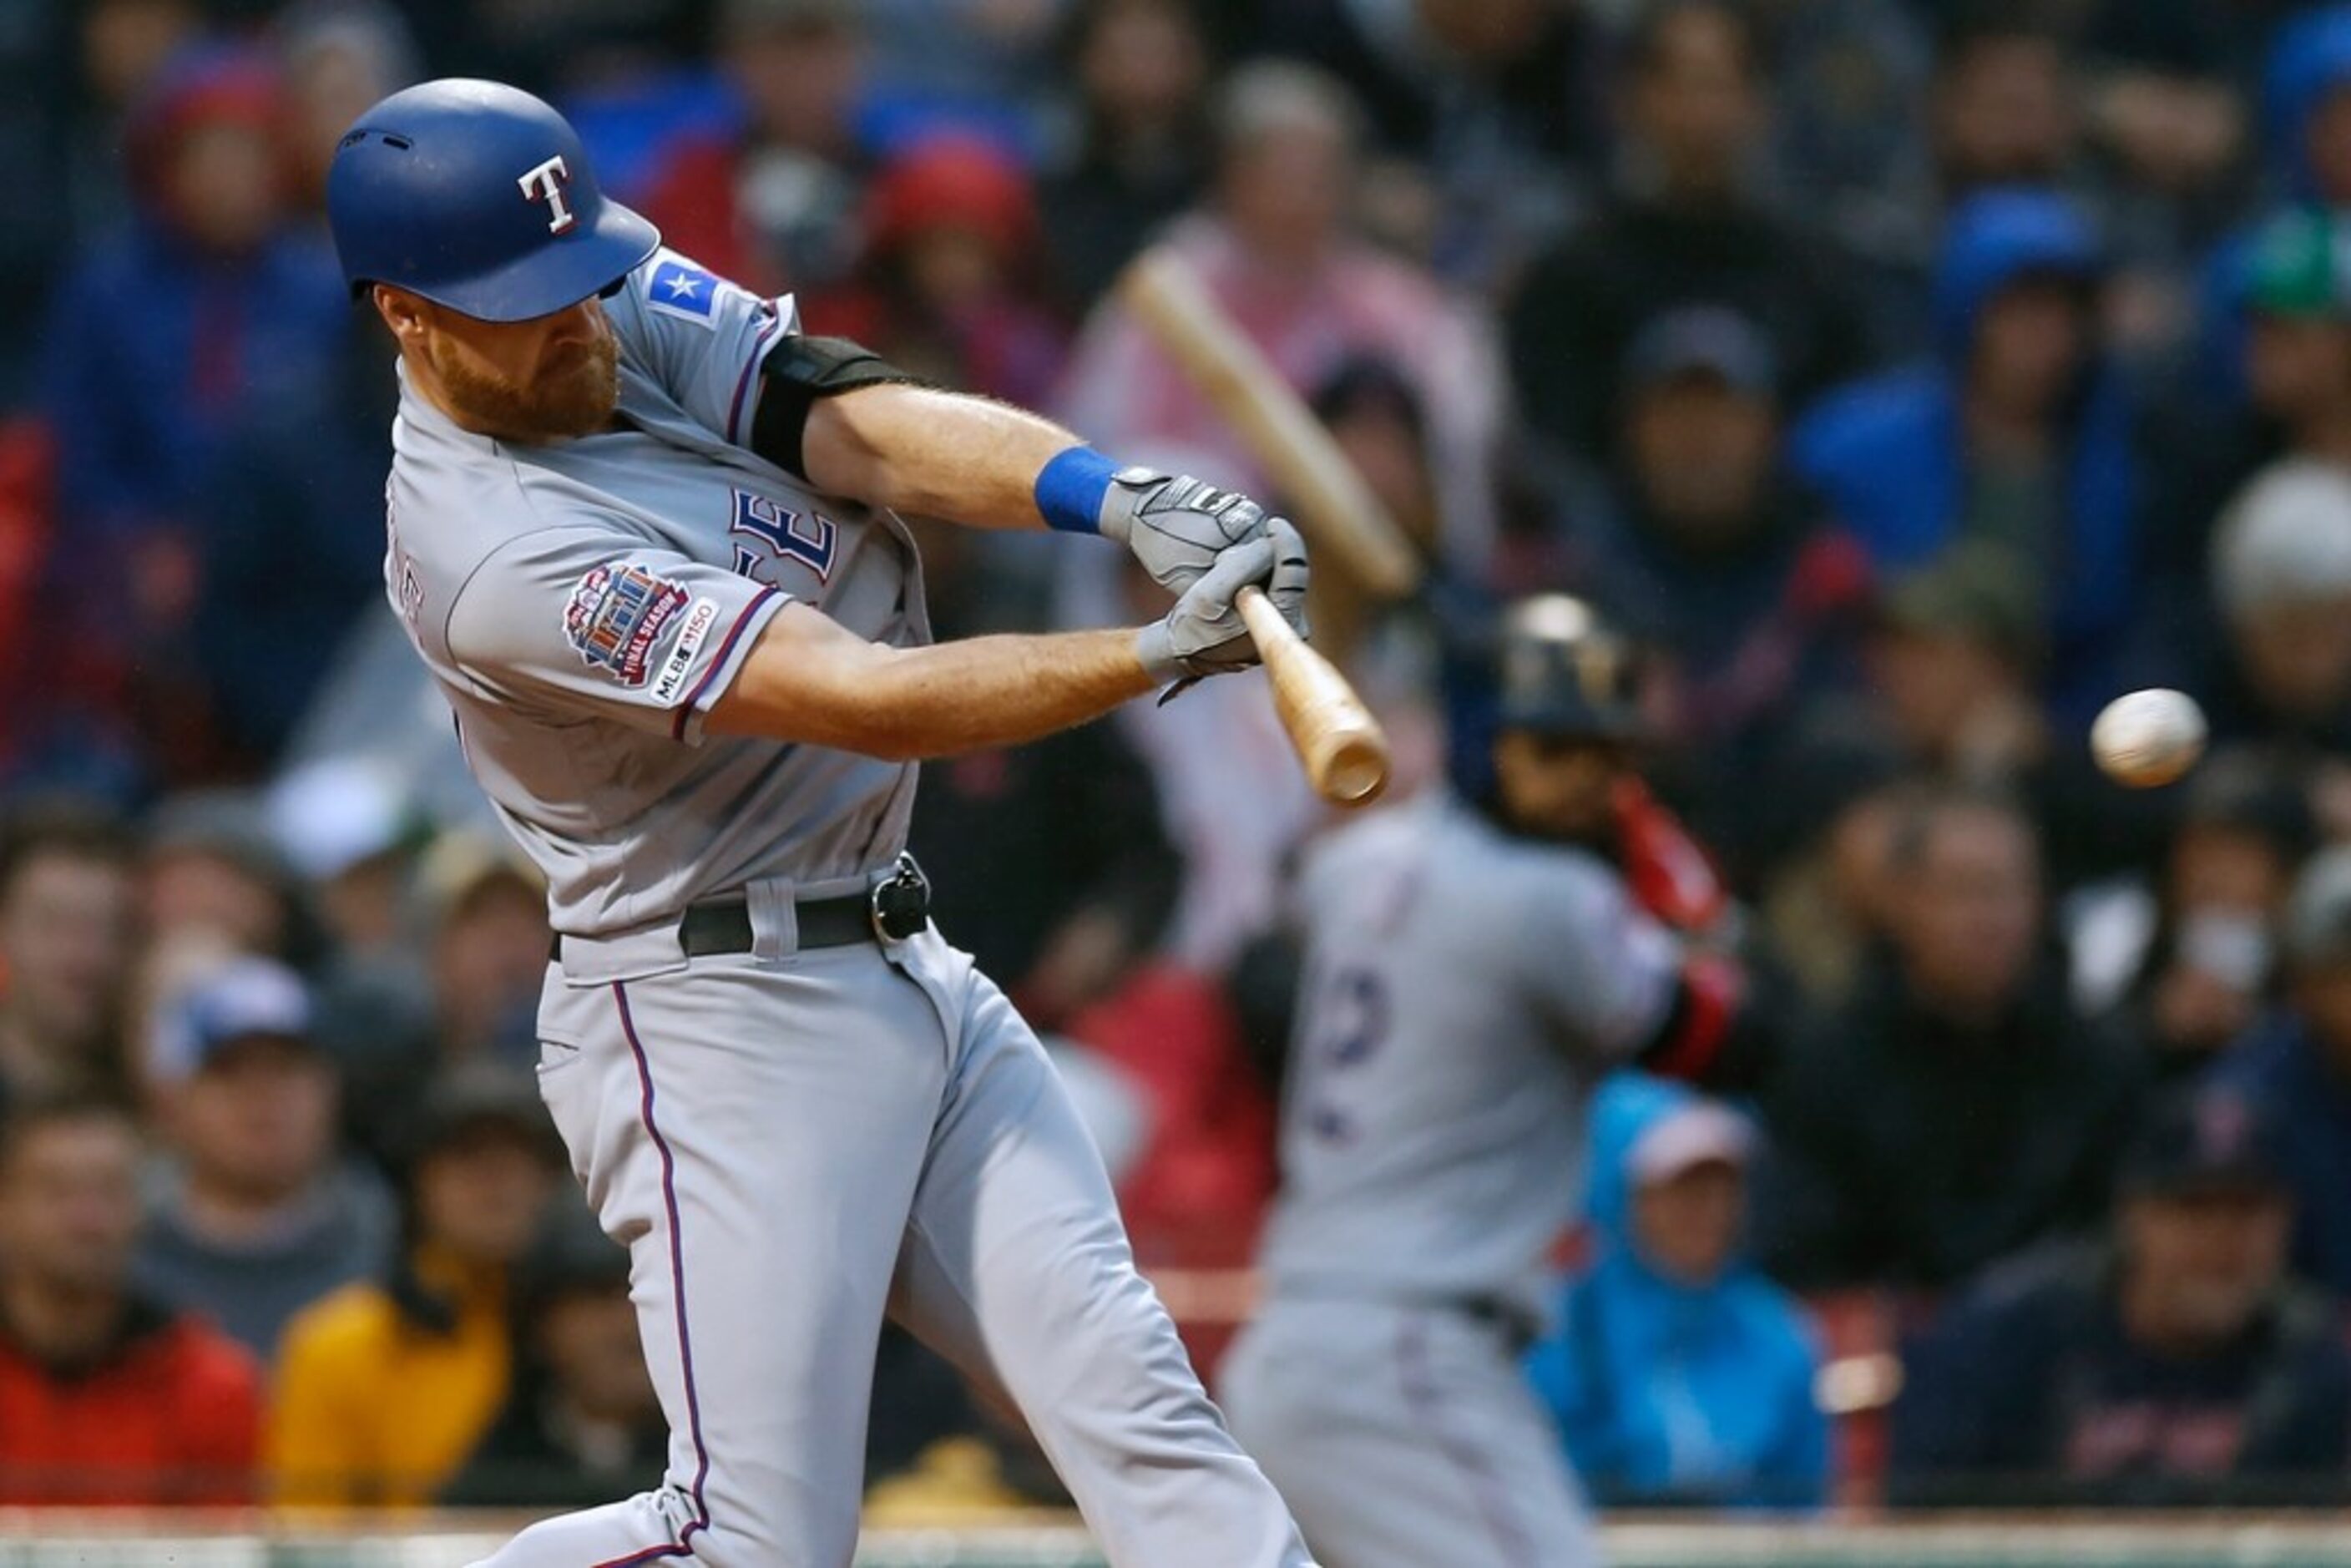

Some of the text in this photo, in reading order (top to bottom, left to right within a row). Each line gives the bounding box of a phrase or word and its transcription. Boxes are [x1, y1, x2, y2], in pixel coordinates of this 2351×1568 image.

[517, 154, 578, 235] T
[624, 592, 678, 673] FINAL SEASON
[657, 659, 685, 700] MLB
